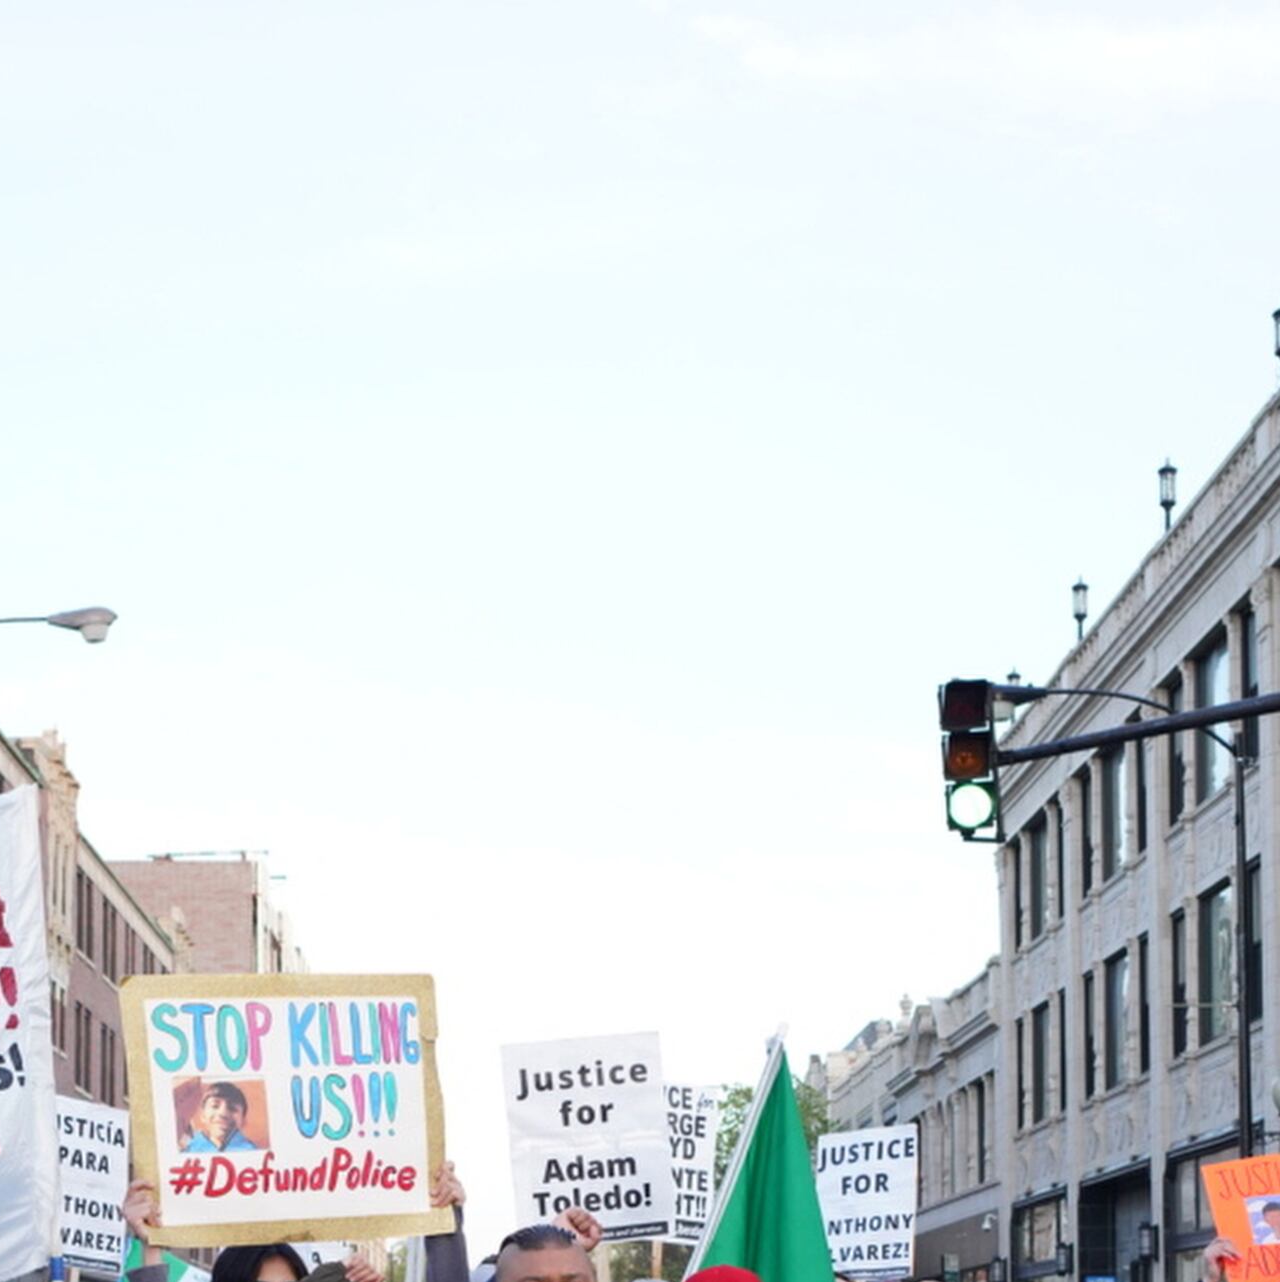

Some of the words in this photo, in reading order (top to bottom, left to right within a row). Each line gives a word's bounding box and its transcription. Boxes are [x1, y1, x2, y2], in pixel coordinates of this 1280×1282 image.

[151, 1002, 272, 1071] STOP
[287, 1002, 420, 1067] KILLING
[517, 1060, 648, 1101] Justice
[291, 1072, 399, 1140] US!!!
[560, 1100, 614, 1127] for
[57, 1114, 125, 1148] STICÍA
[59, 1146, 110, 1174] PARA
[542, 1155, 637, 1184] Adam
[817, 1137, 915, 1173] JUSTICE
[169, 1147, 417, 1198] #DefundPolice
[841, 1173, 889, 1196] FOR
[64, 1194, 124, 1222] THONY
[532, 1182, 652, 1217] Toledo!
[827, 1213, 914, 1236] NTHONY
[60, 1227, 122, 1253] VAREZ!
[831, 1242, 910, 1263] VAREZ!
